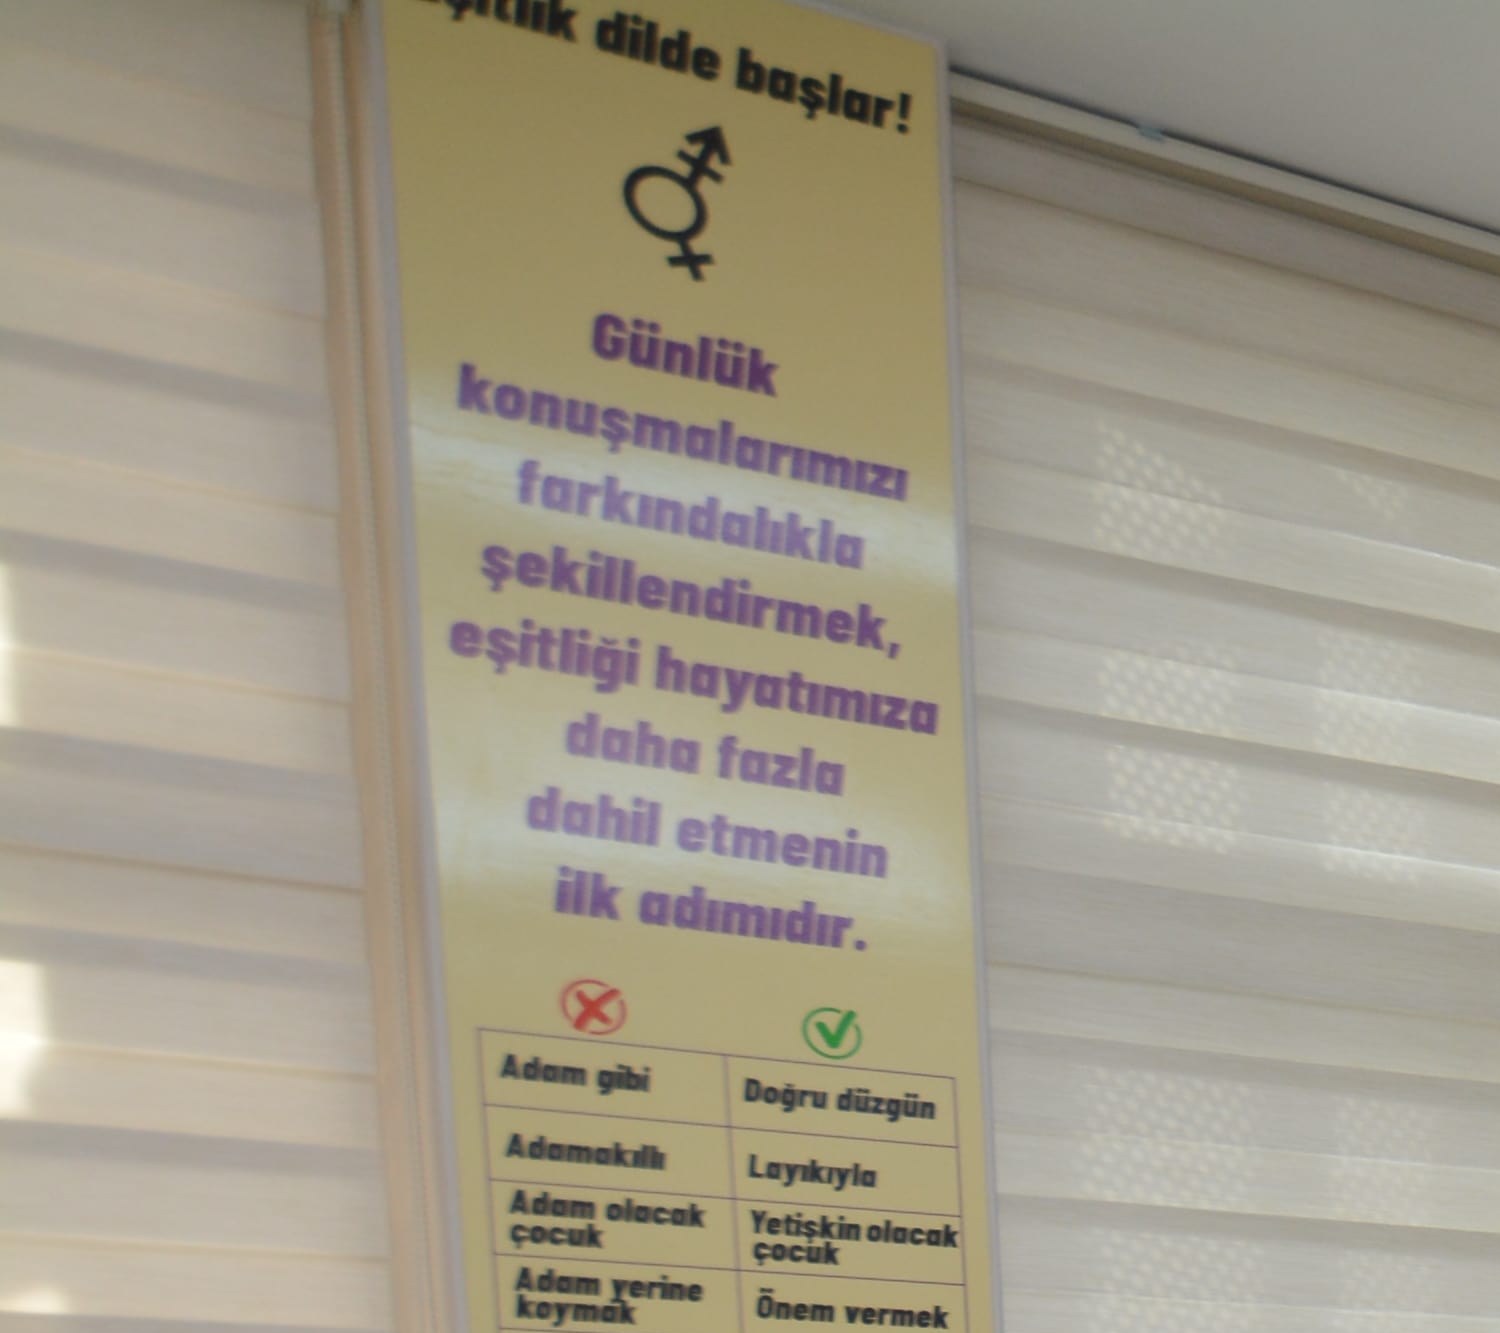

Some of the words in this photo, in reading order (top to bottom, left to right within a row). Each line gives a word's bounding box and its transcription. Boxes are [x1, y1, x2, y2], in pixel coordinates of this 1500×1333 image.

[595, 12, 721, 82] dilde
[737, 48, 912, 134] başlar!
[592, 312, 778, 397] Günlük
[458, 363, 908, 500] konuşmalarımızı
[517, 459, 863, 569] farkındalıkla
[480, 541, 901, 660] şekillendirmek,
[450, 615, 641, 694] eşitliği
[656, 646, 937, 736] hayatımıza
[566, 712, 698, 775] daha
[716, 734, 845, 797] fazla
[527, 789, 659, 848] dahil
[677, 810, 889, 877] etmenin
[555, 866, 620, 923] ilk
[639, 891, 867, 953] adımıdır.
[501, 1054, 586, 1087] Adam
[597, 1064, 651, 1094] gibi
[745, 1079, 827, 1113] Doğru
[837, 1089, 935, 1123] düzgün
[506, 1134, 667, 1170] Adamakıllı
[748, 1154, 877, 1190] Layıkıyla
[509, 1190, 595, 1221] Adam
[606, 1202, 705, 1228] olacak
[752, 1210, 860, 1241] Yetişkin
[867, 1221, 958, 1248] olacak
[510, 1221, 604, 1249] çocuk
[753, 1239, 838, 1265] çocuk
[516, 1267, 600, 1296] Adam
[612, 1275, 703, 1302] yerine
[516, 1295, 635, 1326] koymak
[756, 1288, 835, 1323] Önem
[845, 1304, 949, 1330] vermek
